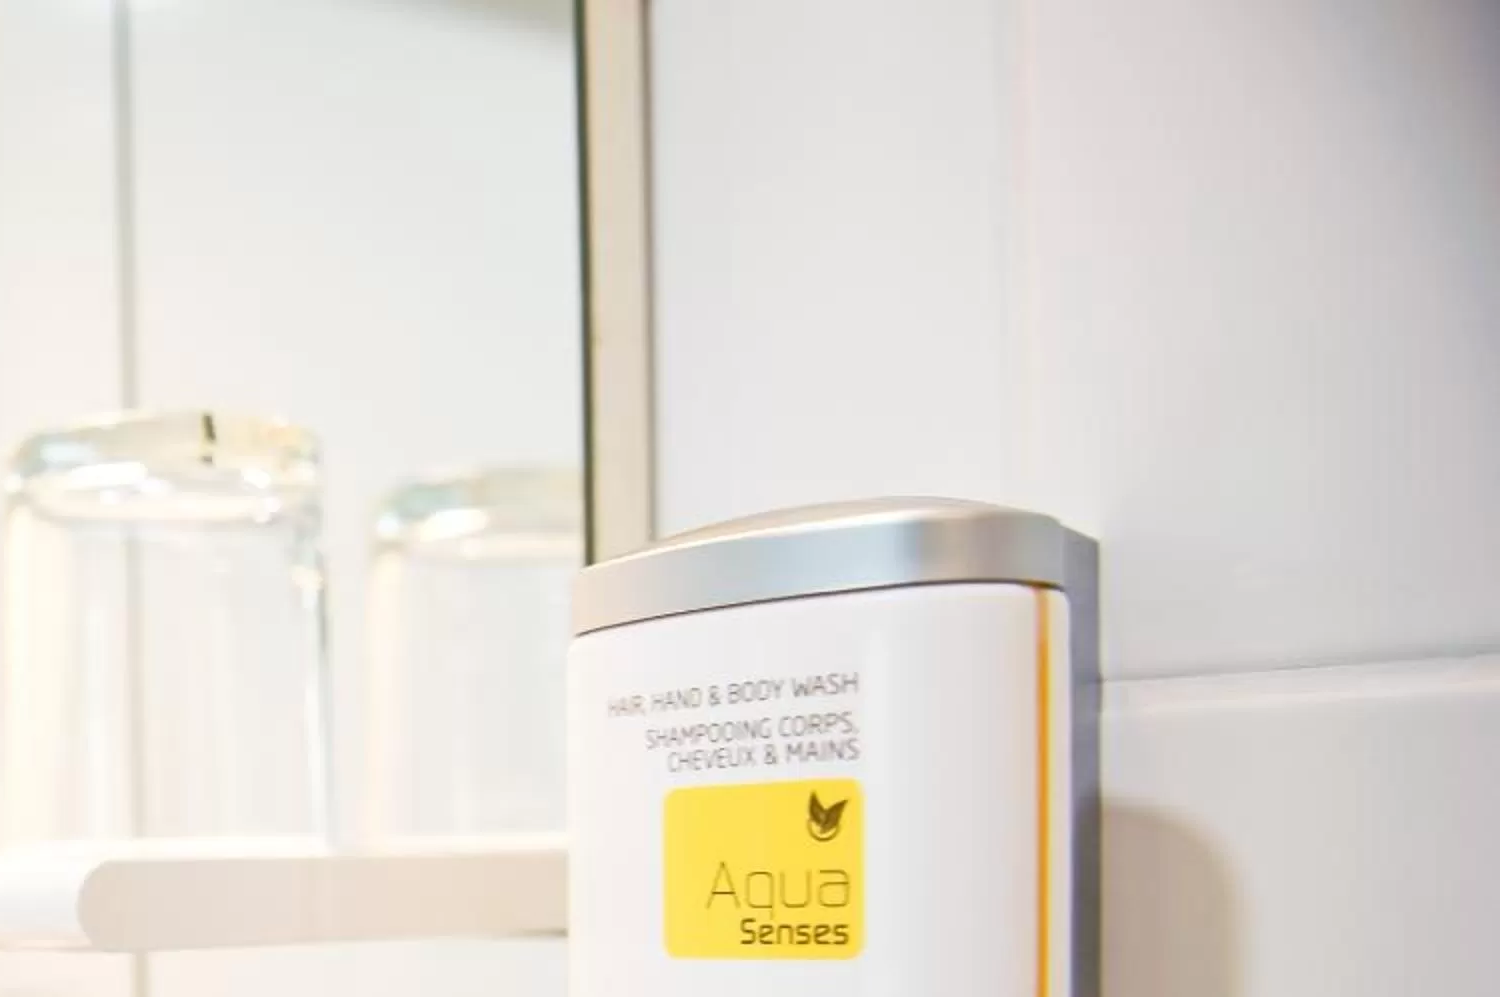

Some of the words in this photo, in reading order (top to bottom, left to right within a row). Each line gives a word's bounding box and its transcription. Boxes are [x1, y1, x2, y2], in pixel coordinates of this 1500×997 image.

[651, 687, 702, 712] HAND
[708, 685, 721, 706] &
[727, 680, 783, 704] BODY
[791, 672, 859, 698] WASH
[645, 718, 772, 750] SHAMPOOING
[667, 746, 755, 773] CHEVEUX
[764, 744, 778, 765] &
[786, 738, 861, 762] MAINS
[705, 861, 850, 920] Aqua
[740, 918, 849, 945] Senses
